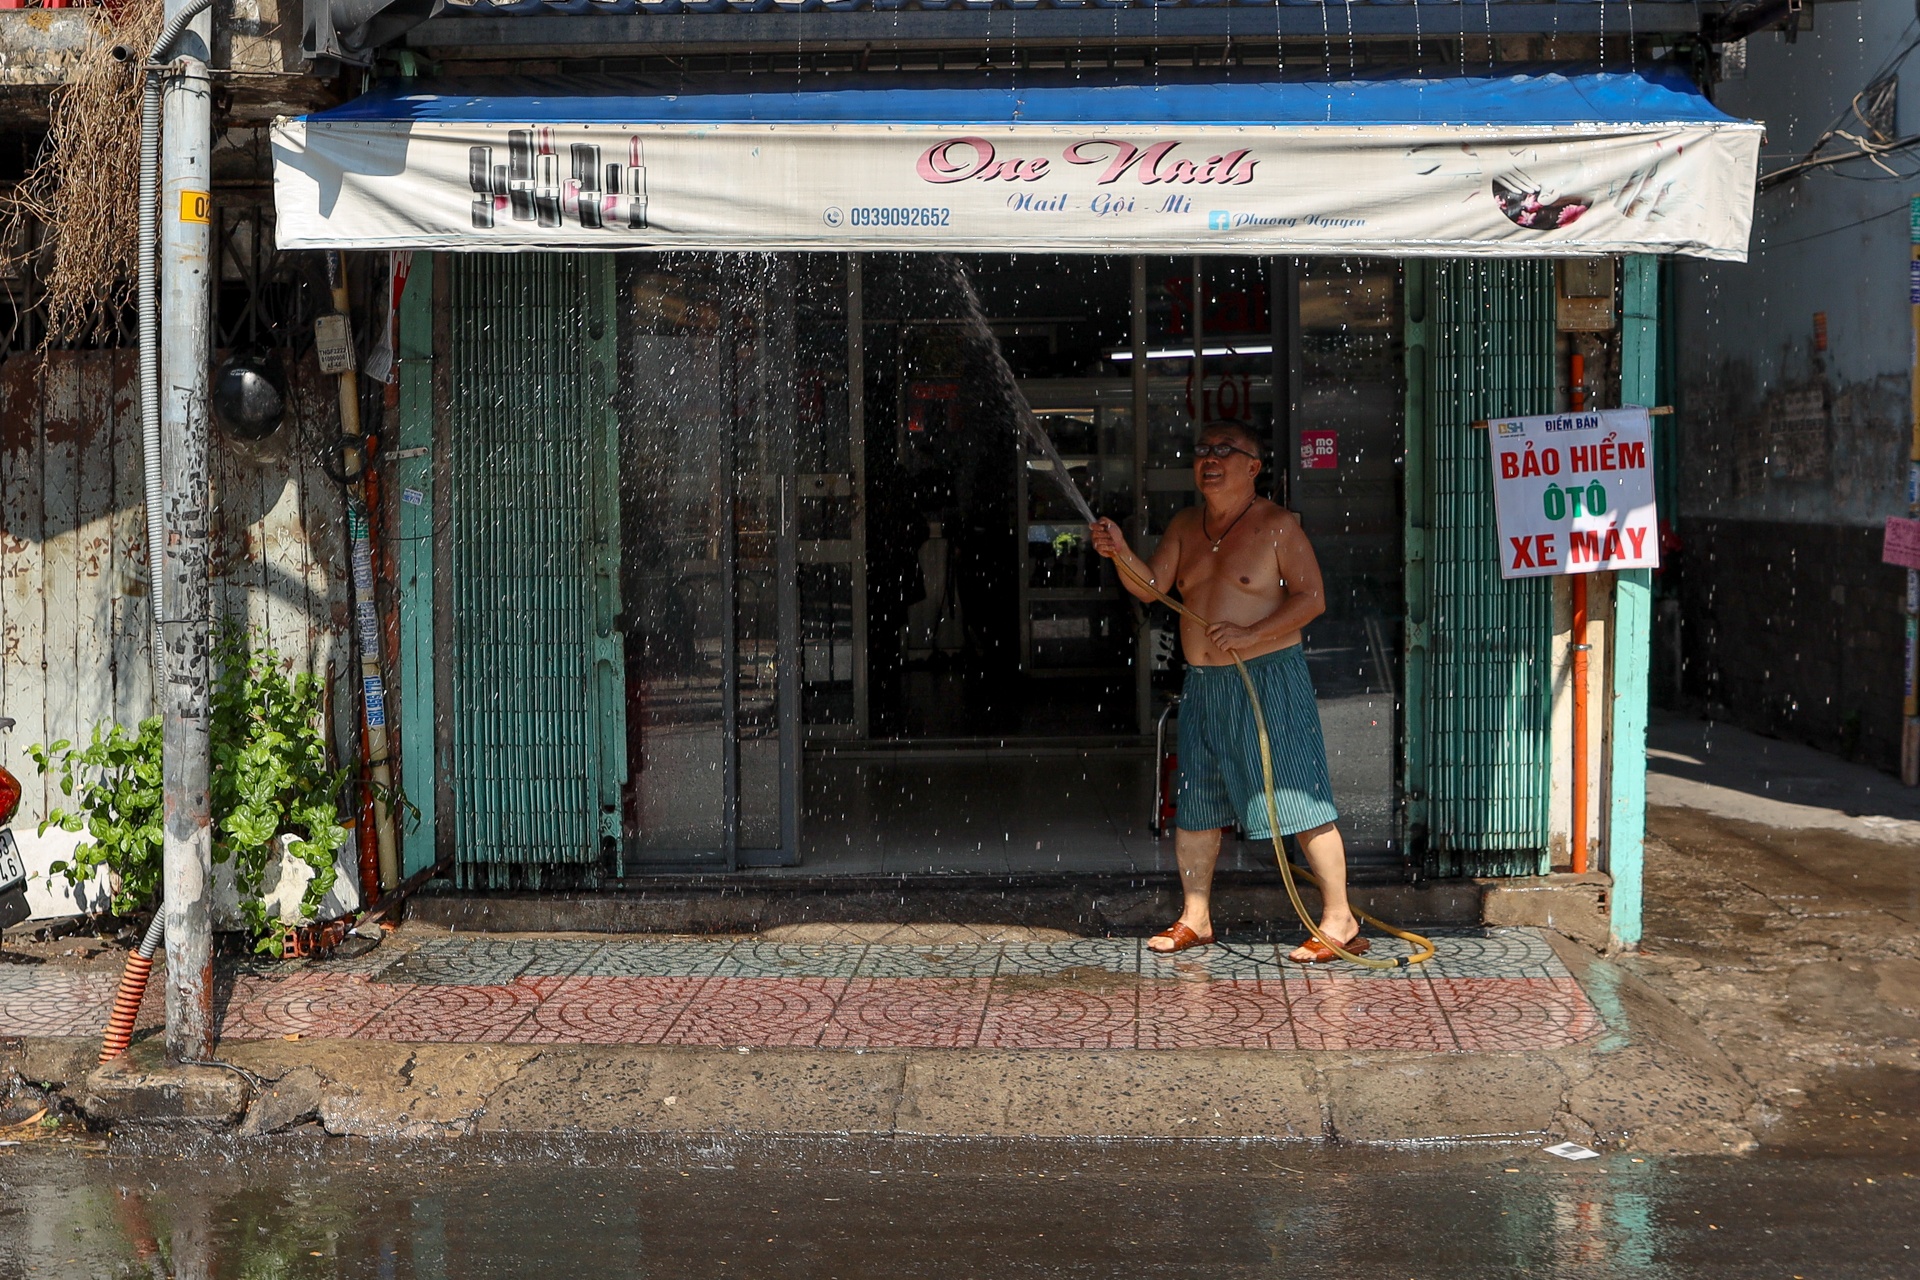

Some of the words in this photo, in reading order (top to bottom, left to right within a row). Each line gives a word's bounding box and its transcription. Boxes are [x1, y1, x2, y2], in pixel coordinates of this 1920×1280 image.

[916, 136, 1051, 184] One
[1062, 139, 1261, 185] Nails
[851, 207, 950, 226] 0939092652
[1007, 192, 1068, 212] Nail
[1089, 192, 1135, 217] Gội
[1155, 194, 1192, 213] Mi
[1232, 213, 1298, 228] Phuong
[1303, 213, 1366, 228] Nguyen
[1315, 438, 1334, 446] mo
[1315, 446, 1334, 455] mo
[1500, 440, 1560, 479] BẢO
[1570, 432, 1646, 473] HIỂM
[1543, 479, 1607, 520] ÔTÔ
[1510, 534, 1557, 569] XE
[1569, 522, 1647, 564] MÁY
